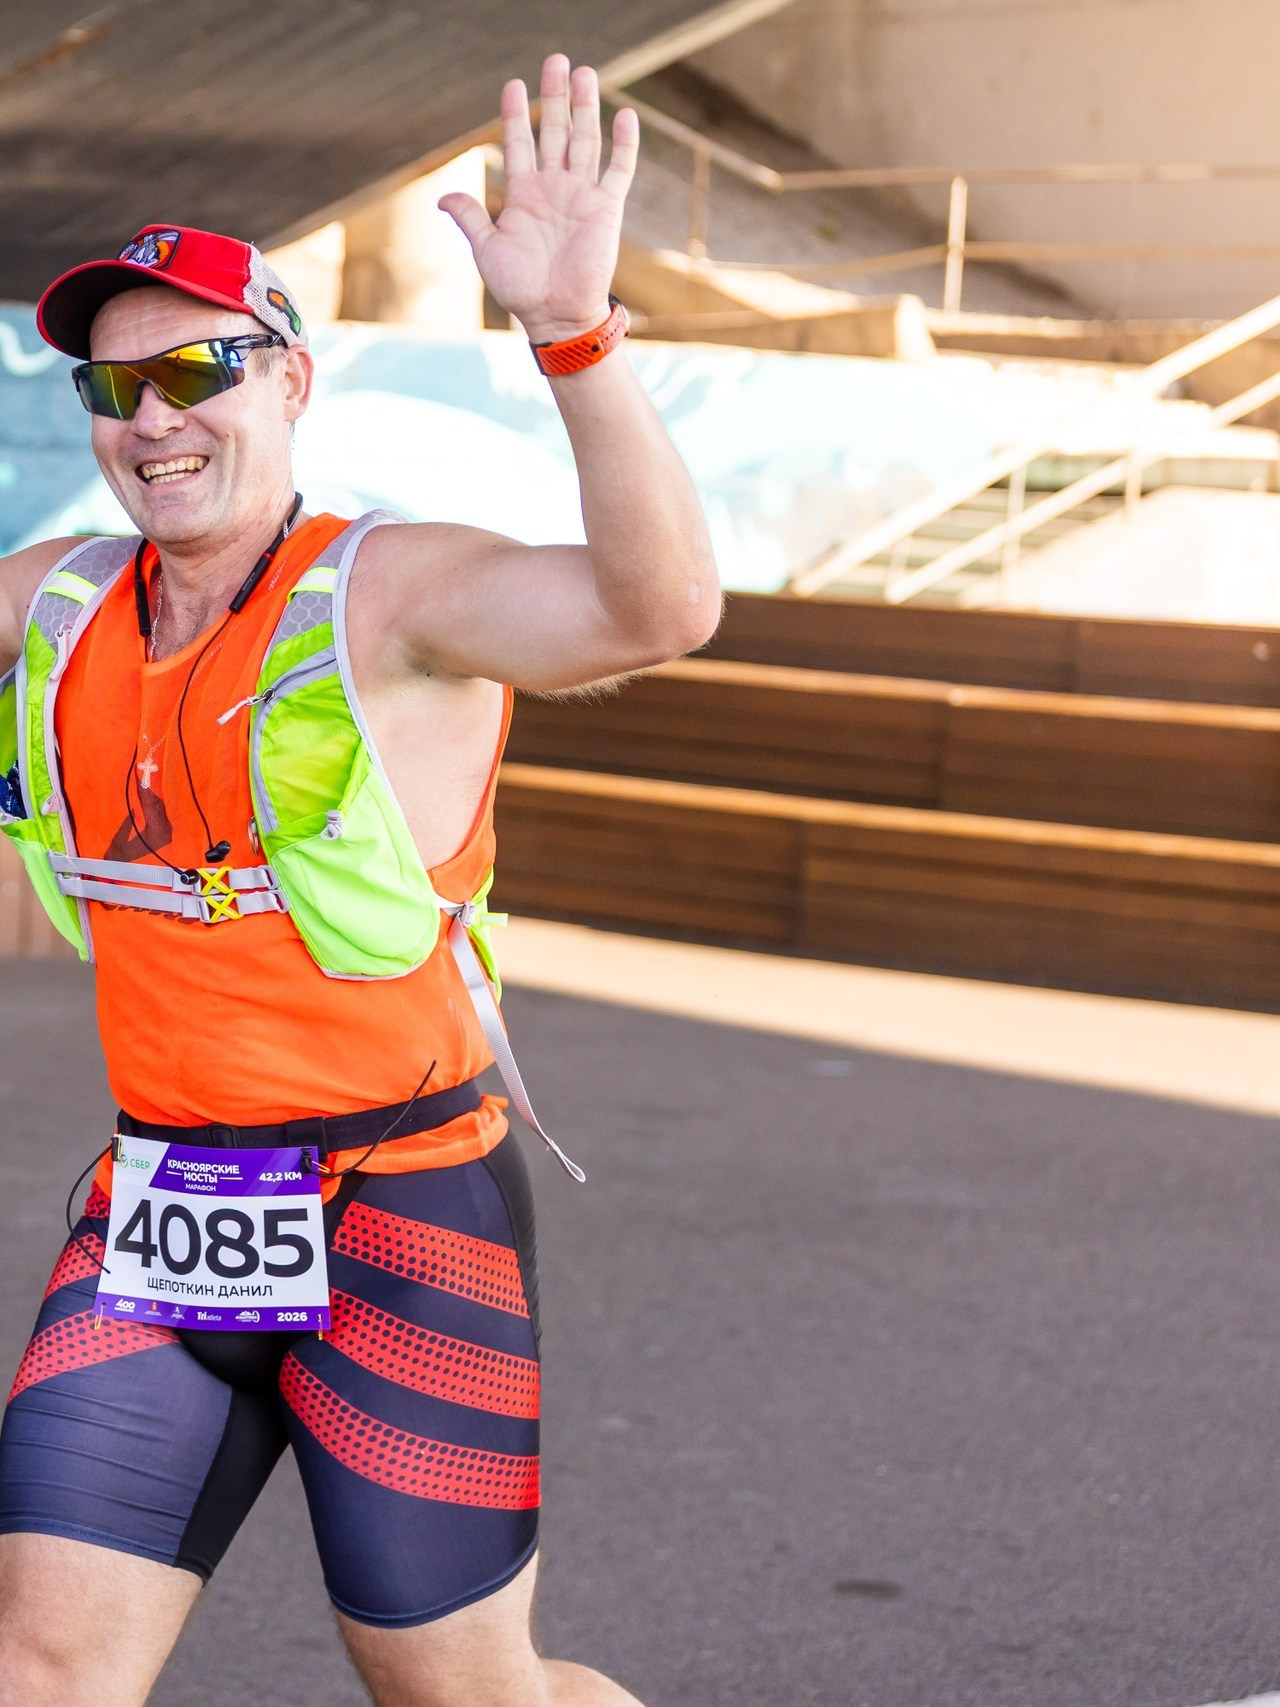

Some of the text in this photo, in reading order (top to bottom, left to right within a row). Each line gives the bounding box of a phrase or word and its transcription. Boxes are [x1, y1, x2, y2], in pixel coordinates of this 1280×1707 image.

[129, 1157, 151, 1170] СБЕР
[167, 1158, 240, 1174] КРАСНОЯРСКИЕ
[183, 1171, 218, 1183] МОСТЫ
[258, 1171, 303, 1182] 42,2 КМ
[185, 1183, 217, 1192] МАРАФОН
[114, 1198, 314, 1279] 4085
[147, 1276, 273, 1299] ЩЕПОТКИН ДАНИЛ
[115, 1298, 136, 1310] 400
[277, 1312, 308, 1322] 2026
